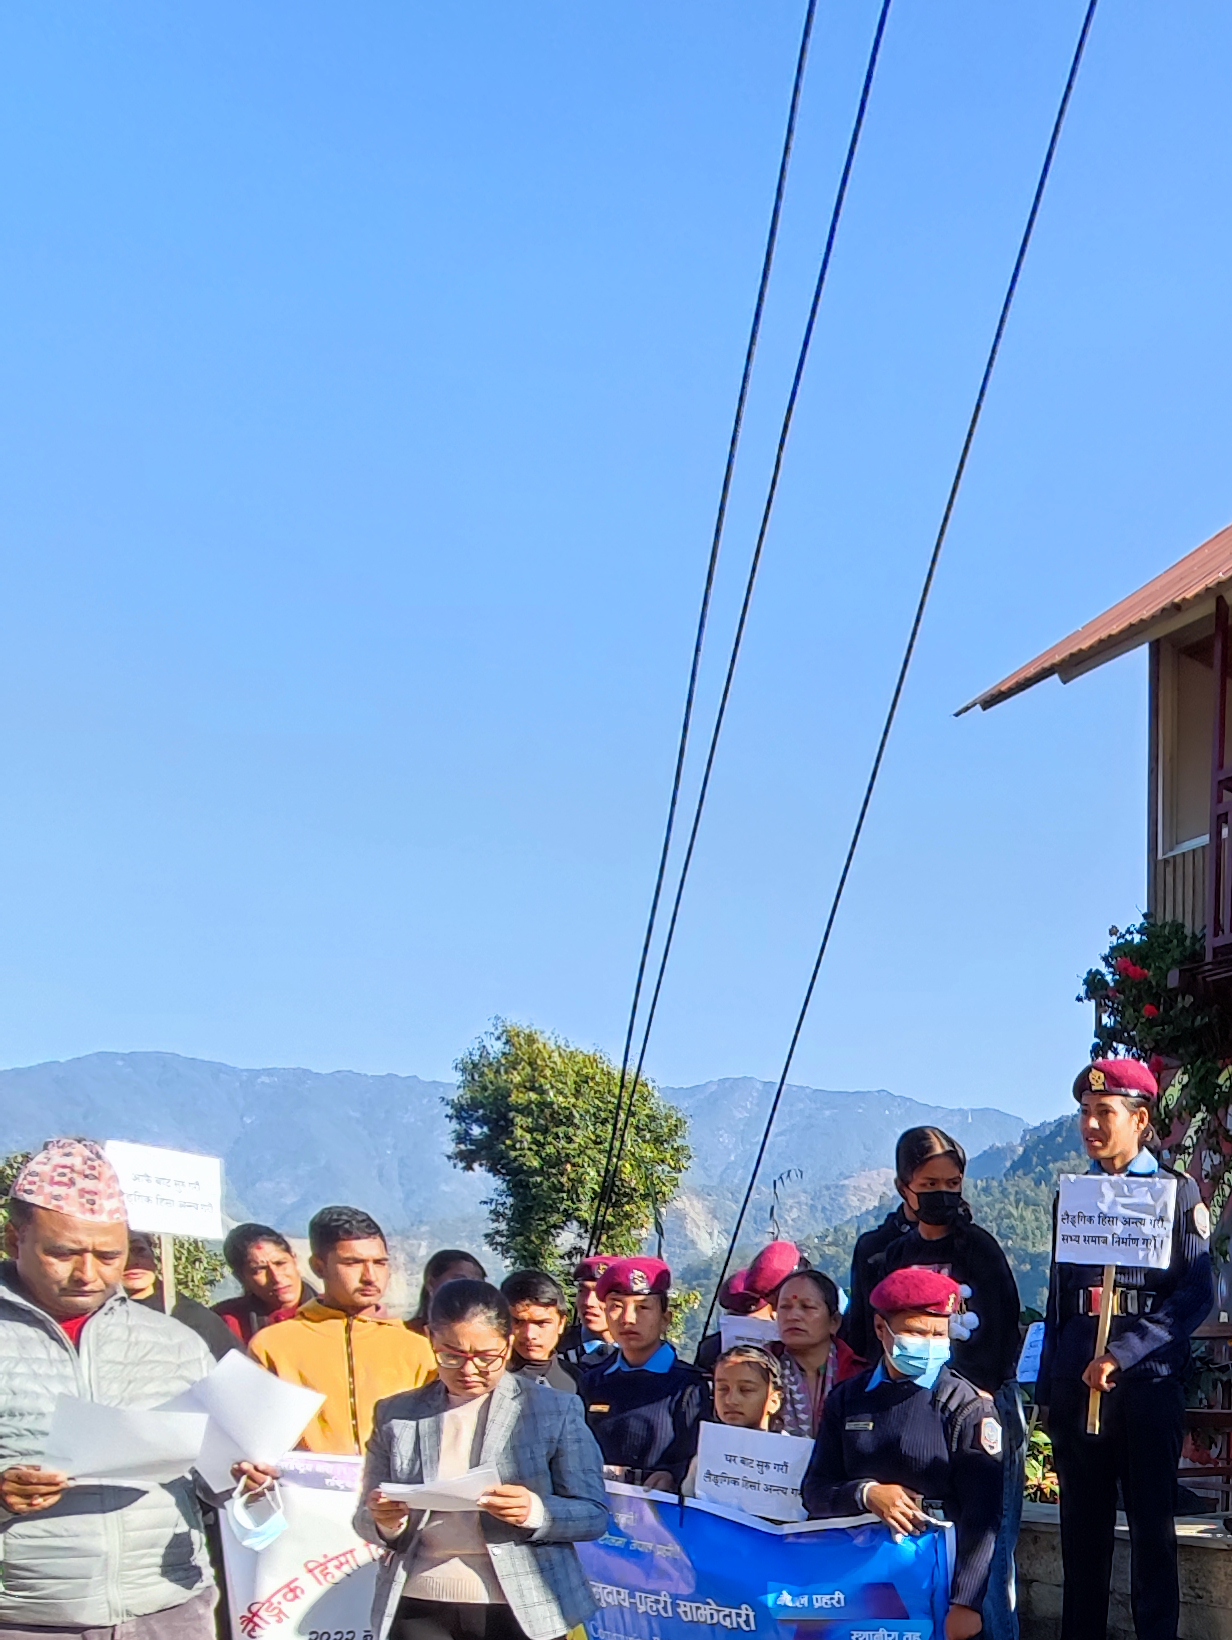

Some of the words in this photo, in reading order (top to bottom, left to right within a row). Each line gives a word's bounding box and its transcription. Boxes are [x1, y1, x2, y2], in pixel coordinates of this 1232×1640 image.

[1111, 1233, 1139, 1247] निर्माण
[812, 1590, 845, 1609] प्रहरी
[676, 1597, 757, 1632] साझेदारी
